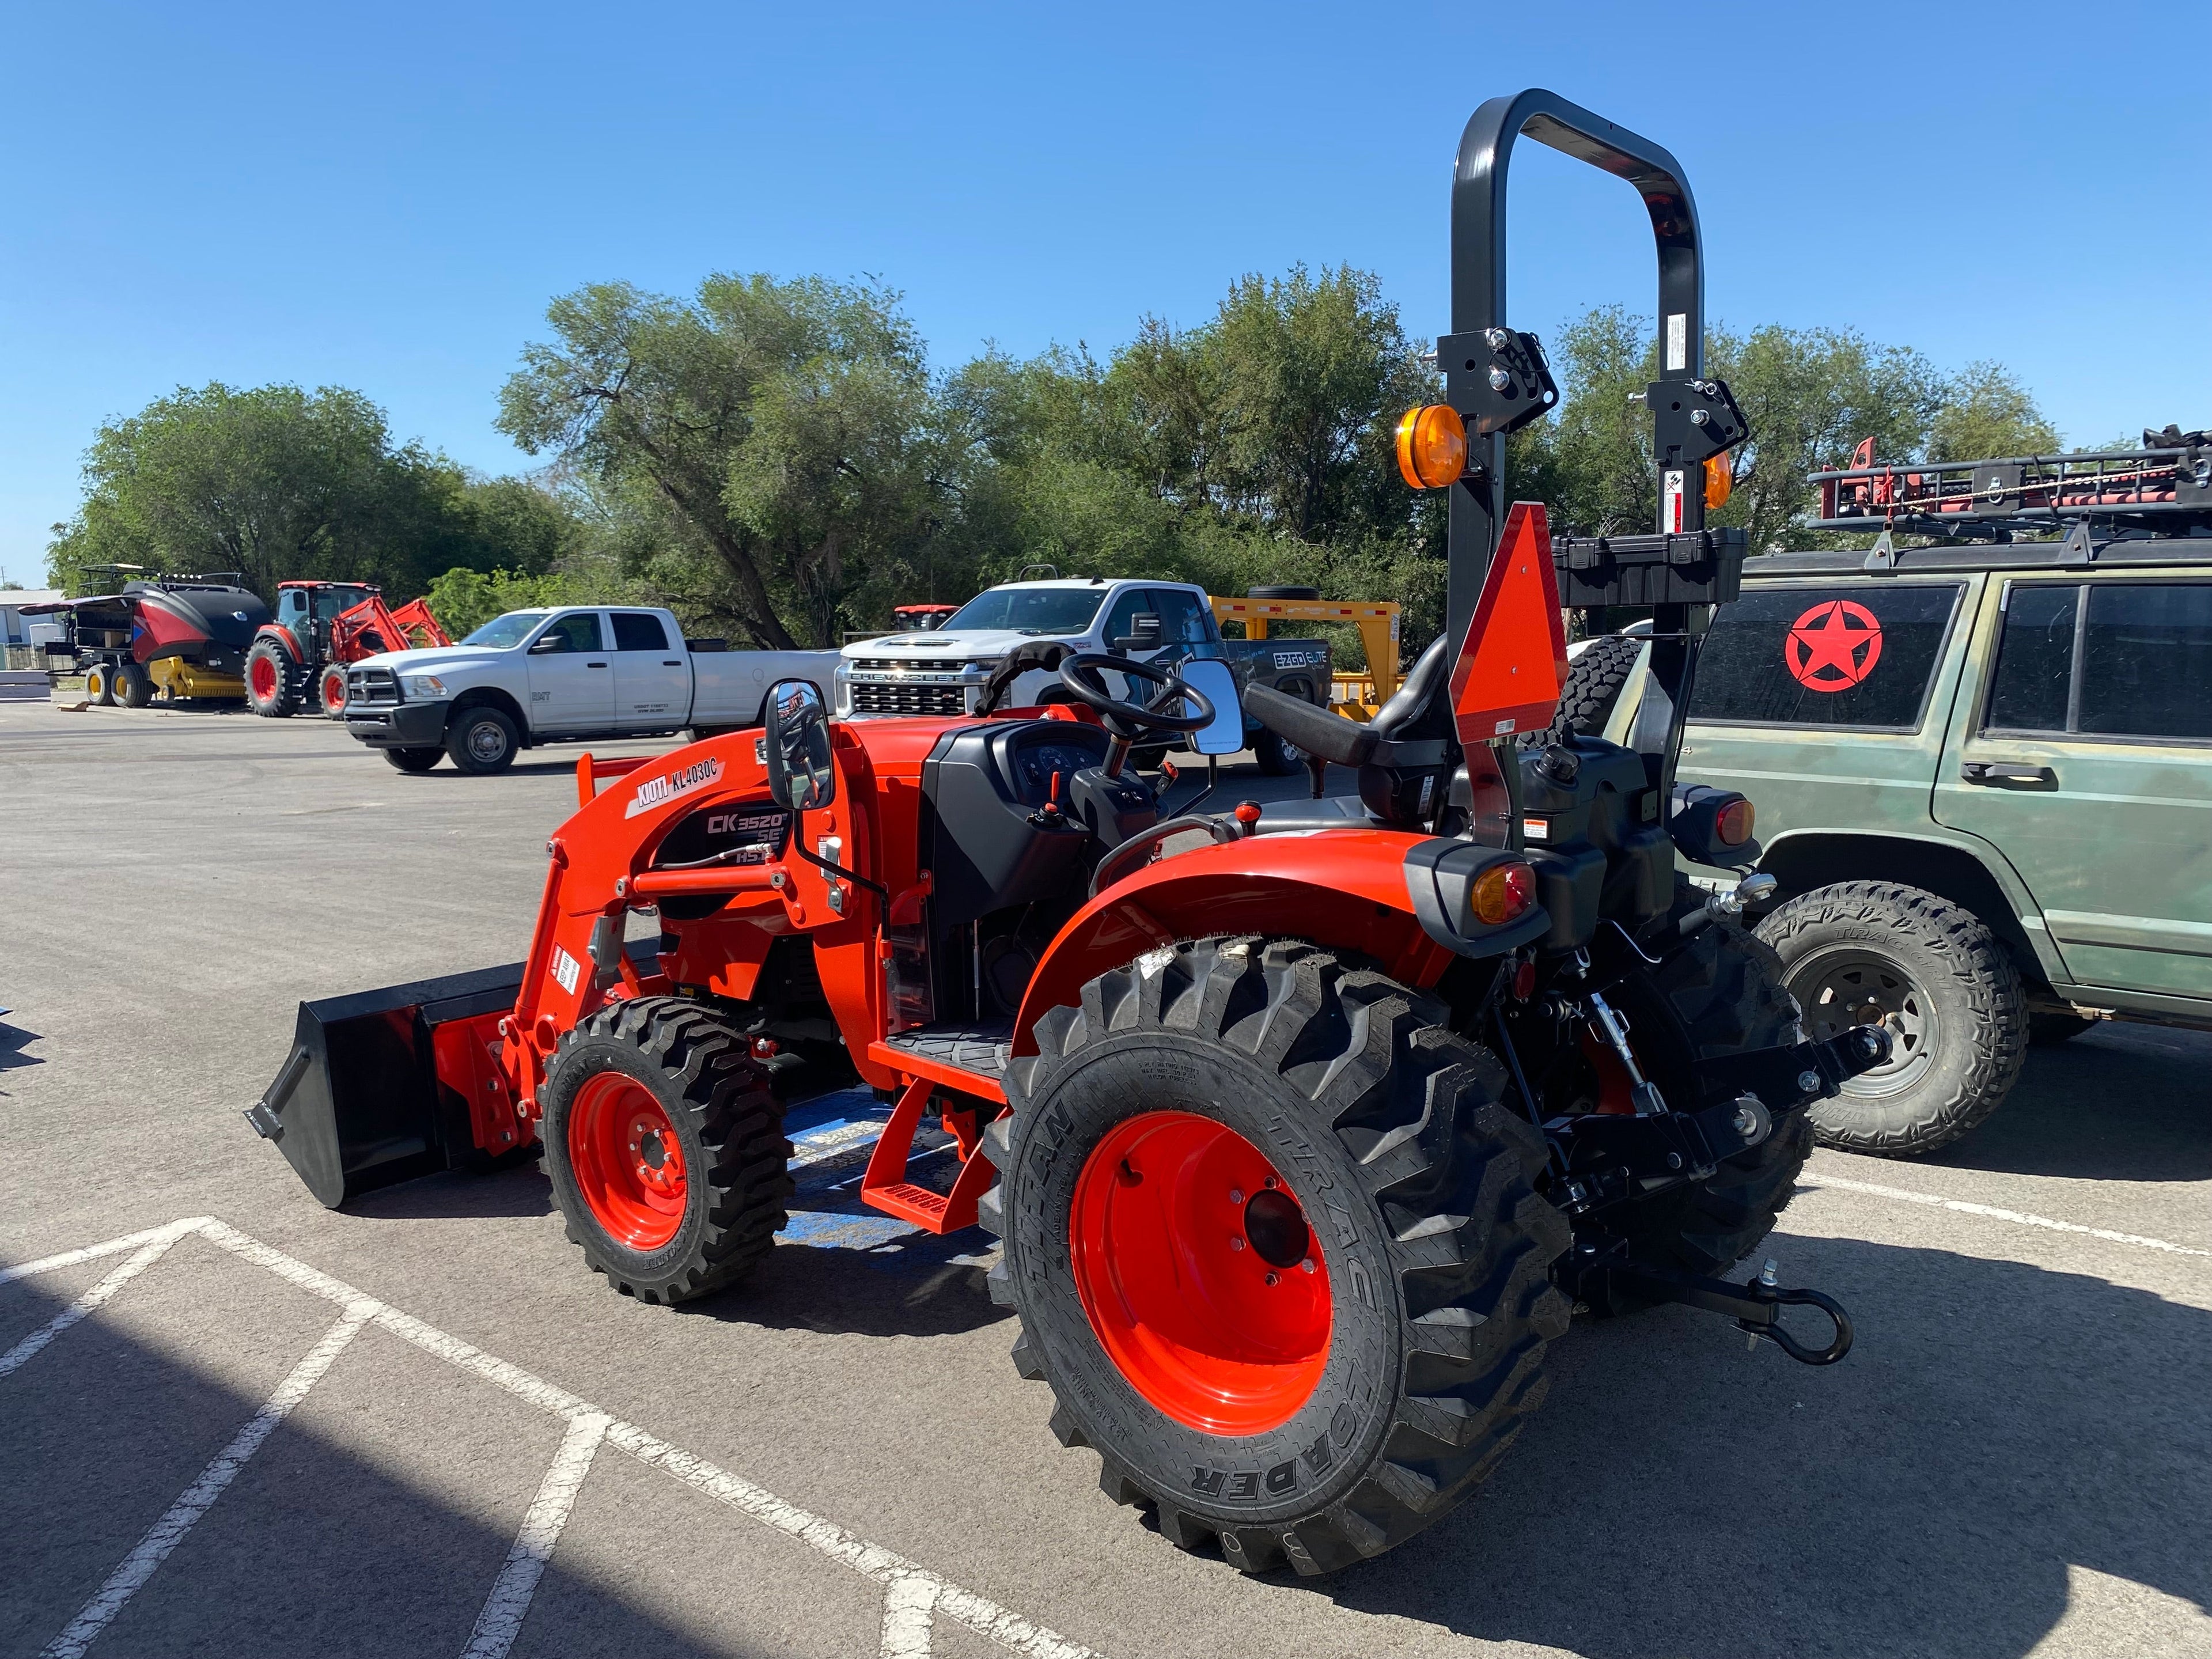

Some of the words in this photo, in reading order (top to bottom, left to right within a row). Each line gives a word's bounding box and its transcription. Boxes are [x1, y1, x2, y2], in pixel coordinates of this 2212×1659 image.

[637, 774, 668, 808] KIOTI
[671, 756, 717, 793] KL4030C
[757, 828, 780, 842] SE
[1834, 926, 1909, 950] TRAC
[1191, 1362, 1372, 1501] LOADER
